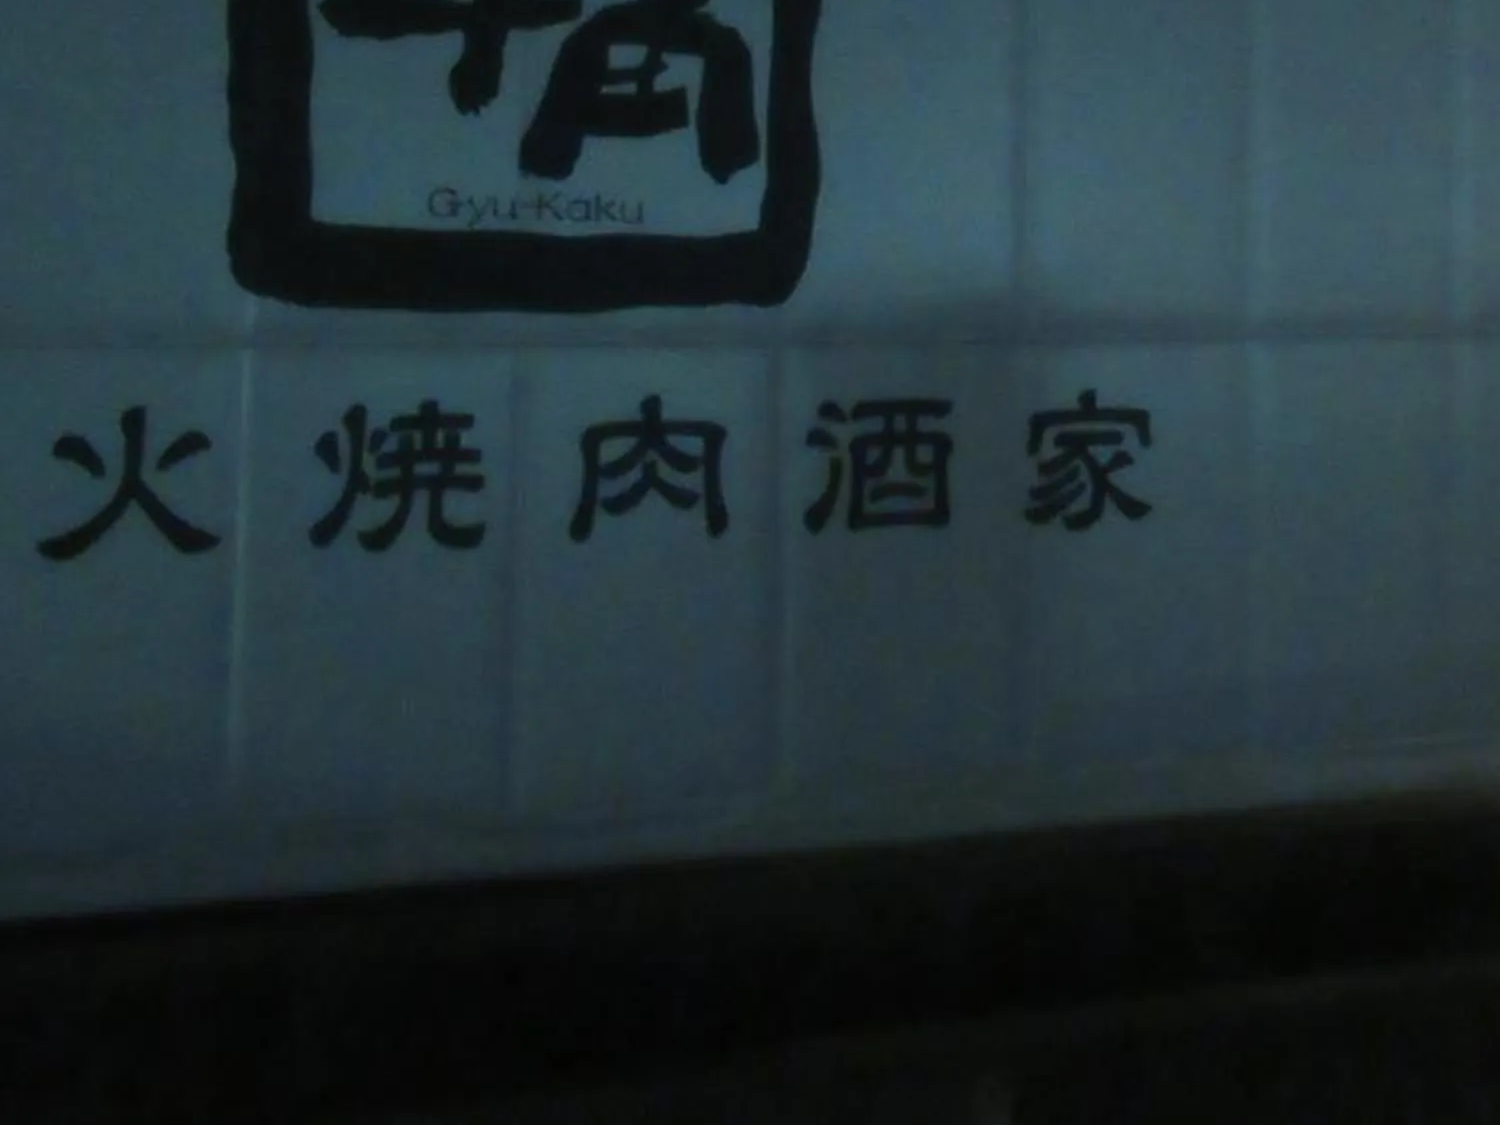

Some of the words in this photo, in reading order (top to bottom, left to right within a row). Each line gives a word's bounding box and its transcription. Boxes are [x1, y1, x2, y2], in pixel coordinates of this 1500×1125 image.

[426, 186, 645, 230] Gyu-Kaku
[37, 388, 1152, 560] 火焼肉酒家
